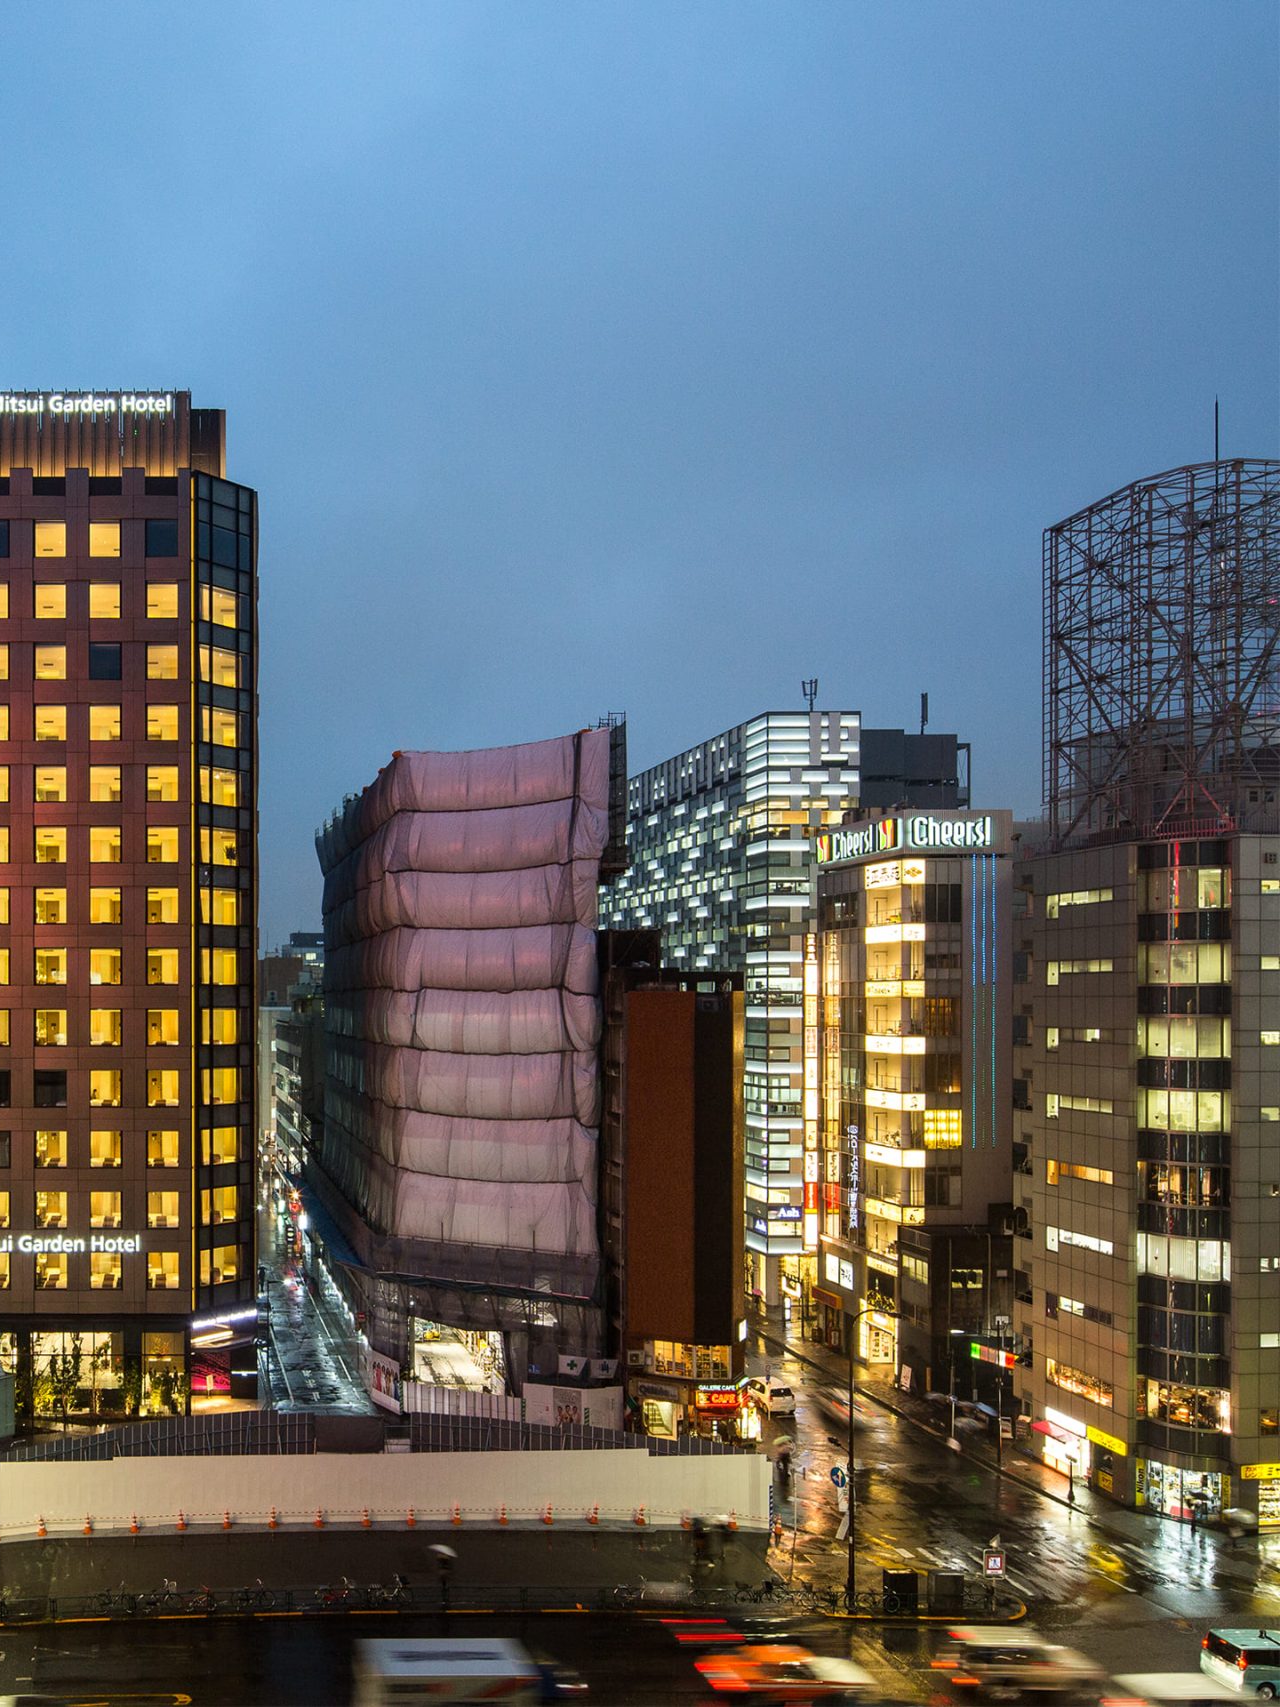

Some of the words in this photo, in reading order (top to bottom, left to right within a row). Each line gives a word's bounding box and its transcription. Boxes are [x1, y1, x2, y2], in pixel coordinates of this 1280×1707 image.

[49, 396, 116, 413] Garden
[121, 395, 172, 413] Hotel
[912, 816, 991, 846] Cheers!
[832, 823, 874, 861] Cheers!
[778, 1206, 801, 1218] Ash
[18, 1235, 85, 1252] Garden
[91, 1235, 140, 1252] Hotel
[711, 1393, 736, 1404] CAFE
[1136, 1468, 1144, 1494] Nikon
